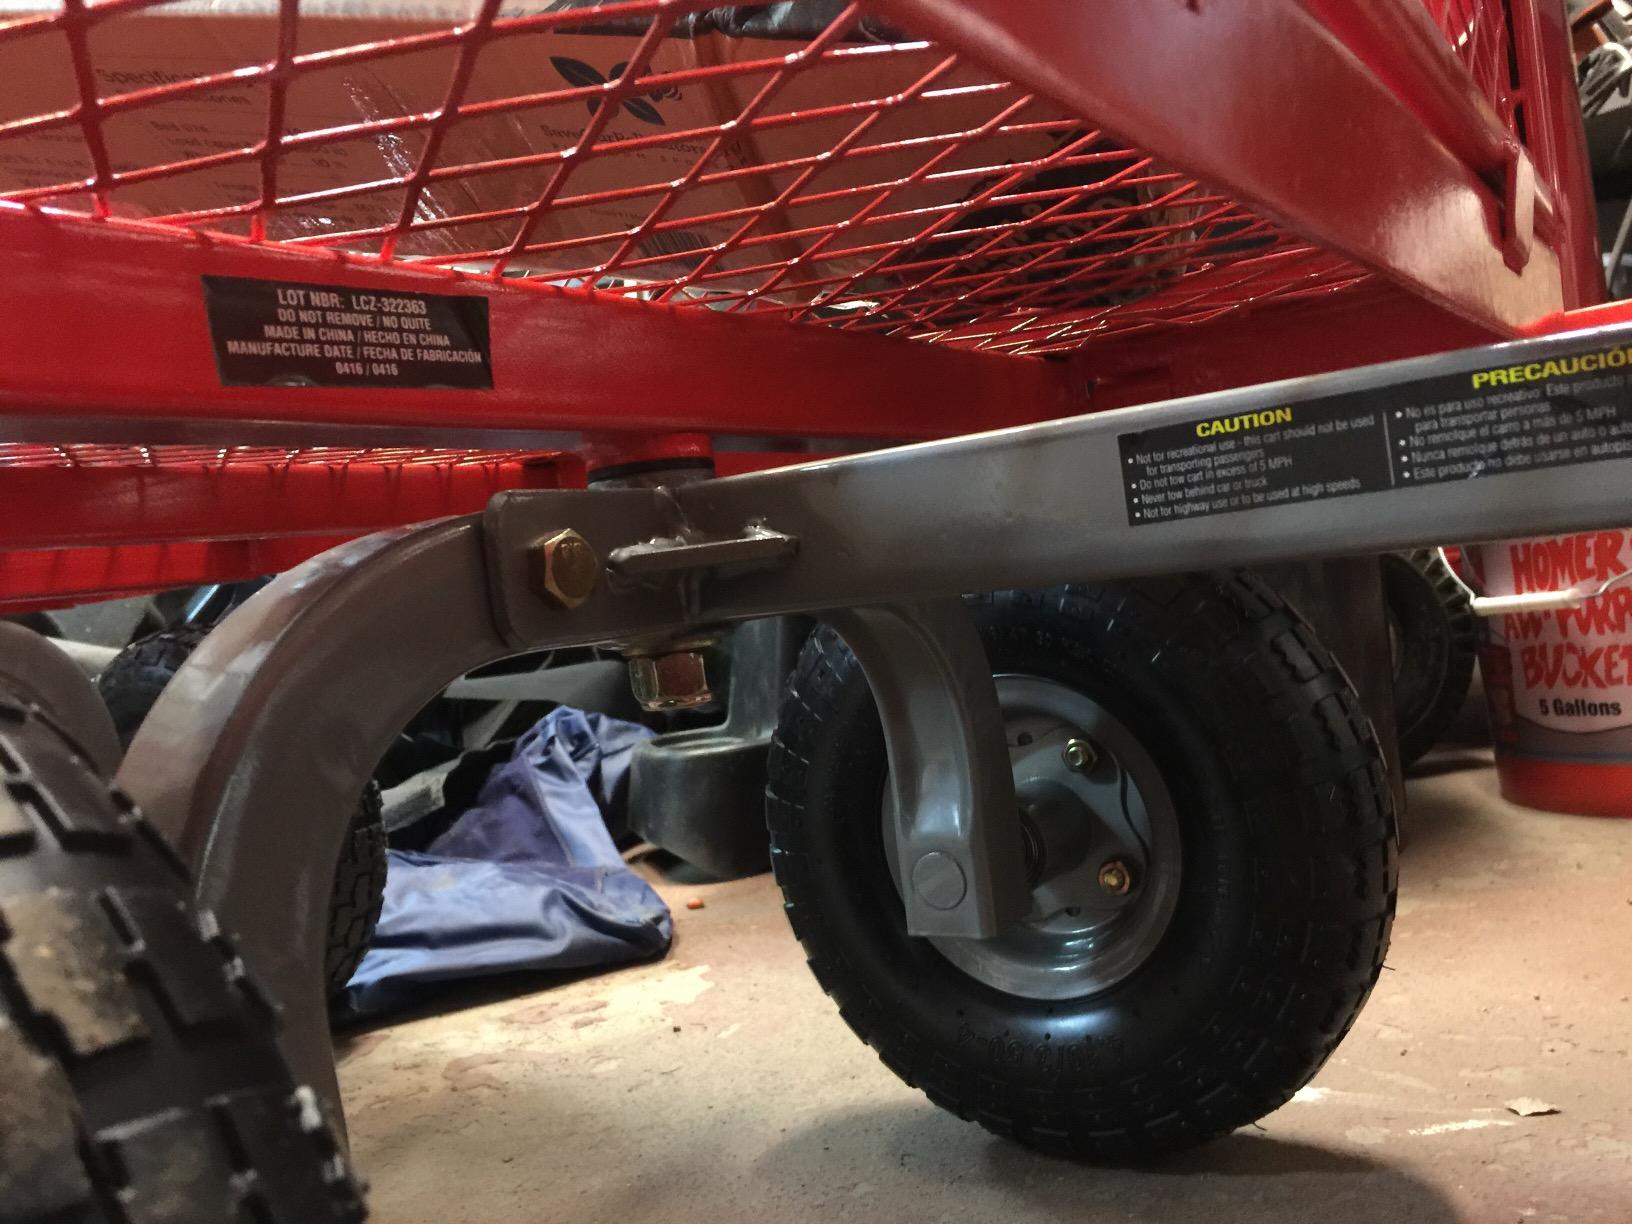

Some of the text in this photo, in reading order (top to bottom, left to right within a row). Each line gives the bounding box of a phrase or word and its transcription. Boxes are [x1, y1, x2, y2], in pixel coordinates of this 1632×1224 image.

[277, 289, 427, 315] LOT NBR: LCZ-322363
[278, 308, 431, 330] DO NOT REMOVE / NO QUITE
[264, 325, 450, 346] MADE IN CHINA / HECHO EN CHINA
[226, 341, 321, 357] MANUFACTURE
[324, 345, 353, 358] DATE
[357, 346, 360, 359] /
[363, 346, 399, 360] FECHA
[401, 348, 414, 360] DE
[336, 361, 399, 376] 0416 / 0416
[1196, 407, 1292, 437] CAUTION
[1539, 698, 1622, 717] 5 Gallons
